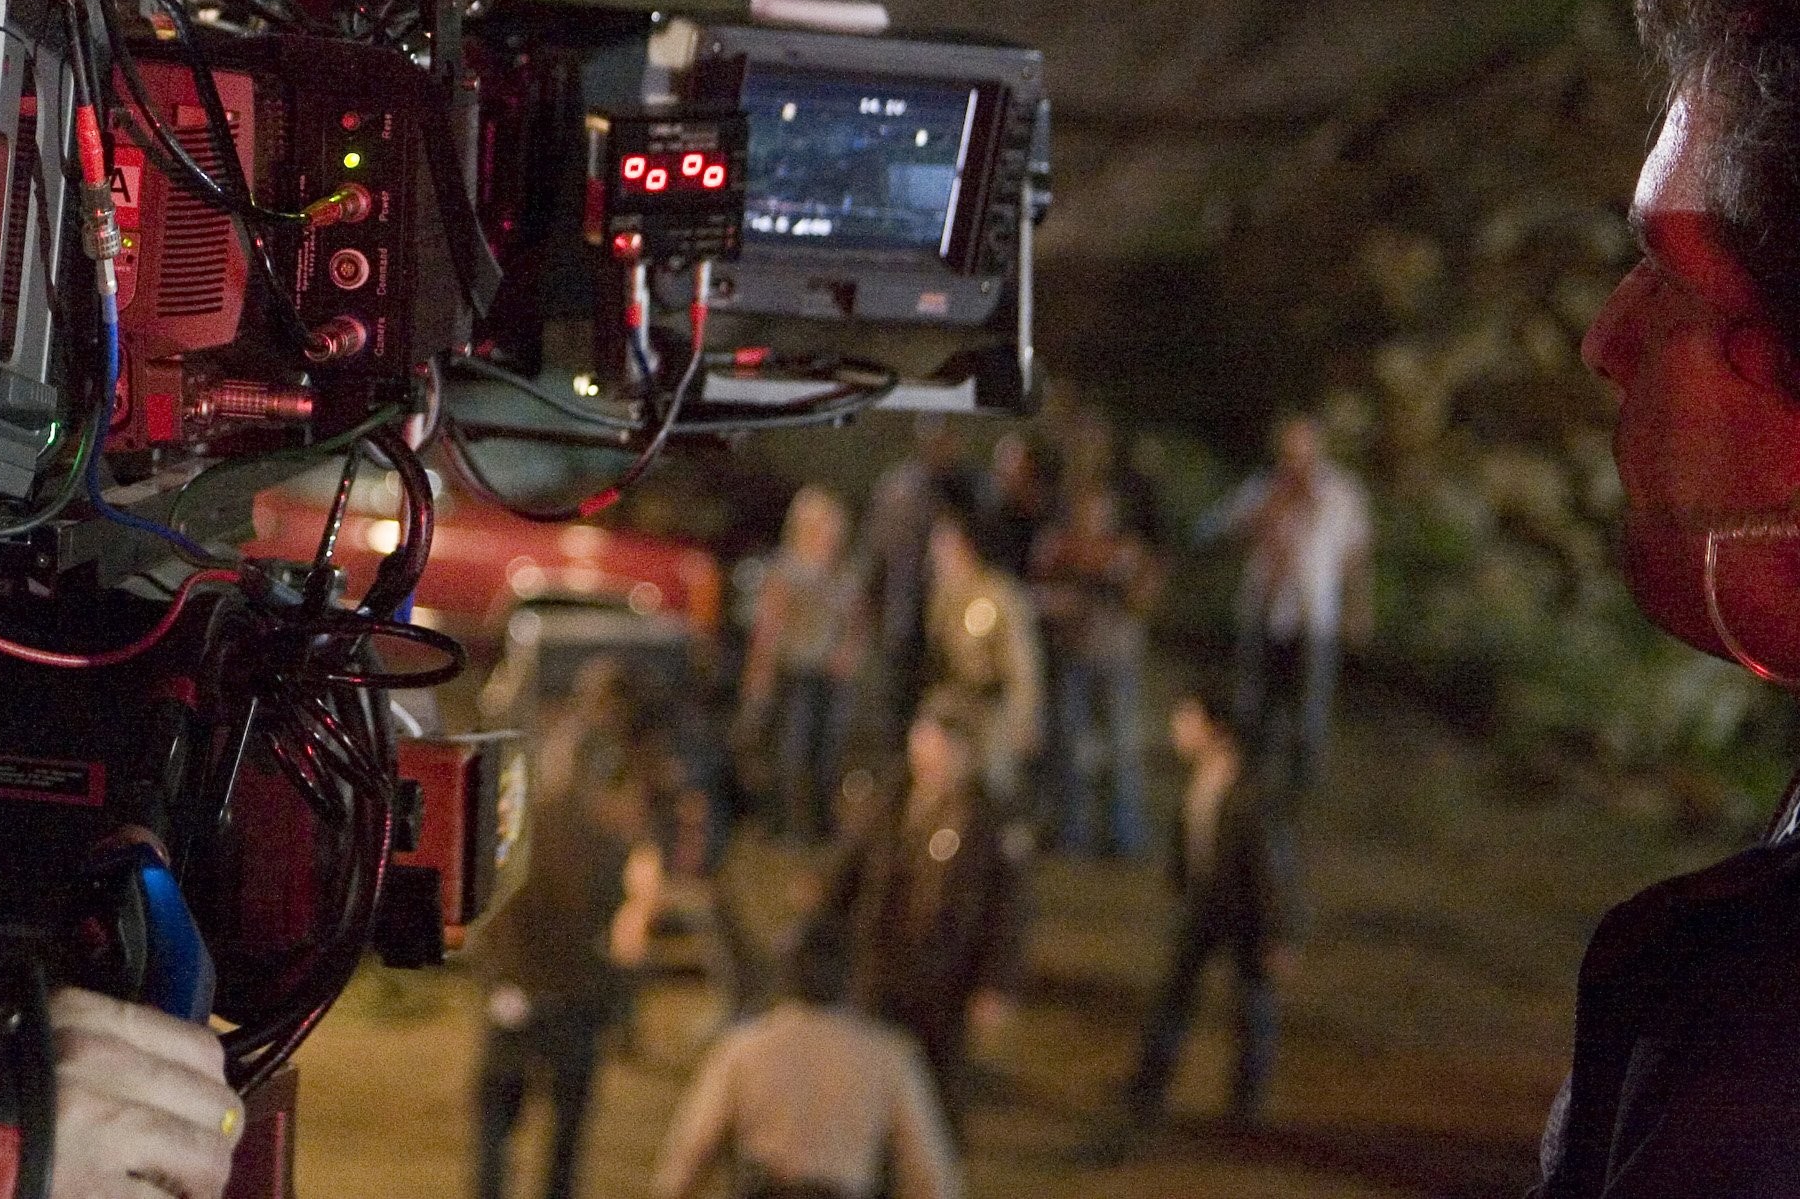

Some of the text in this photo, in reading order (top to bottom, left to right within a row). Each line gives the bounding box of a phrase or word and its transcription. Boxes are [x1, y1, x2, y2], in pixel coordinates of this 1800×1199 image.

[110, 167, 131, 203] A
[379, 190, 389, 221] Power
[376, 248, 388, 296] Command
